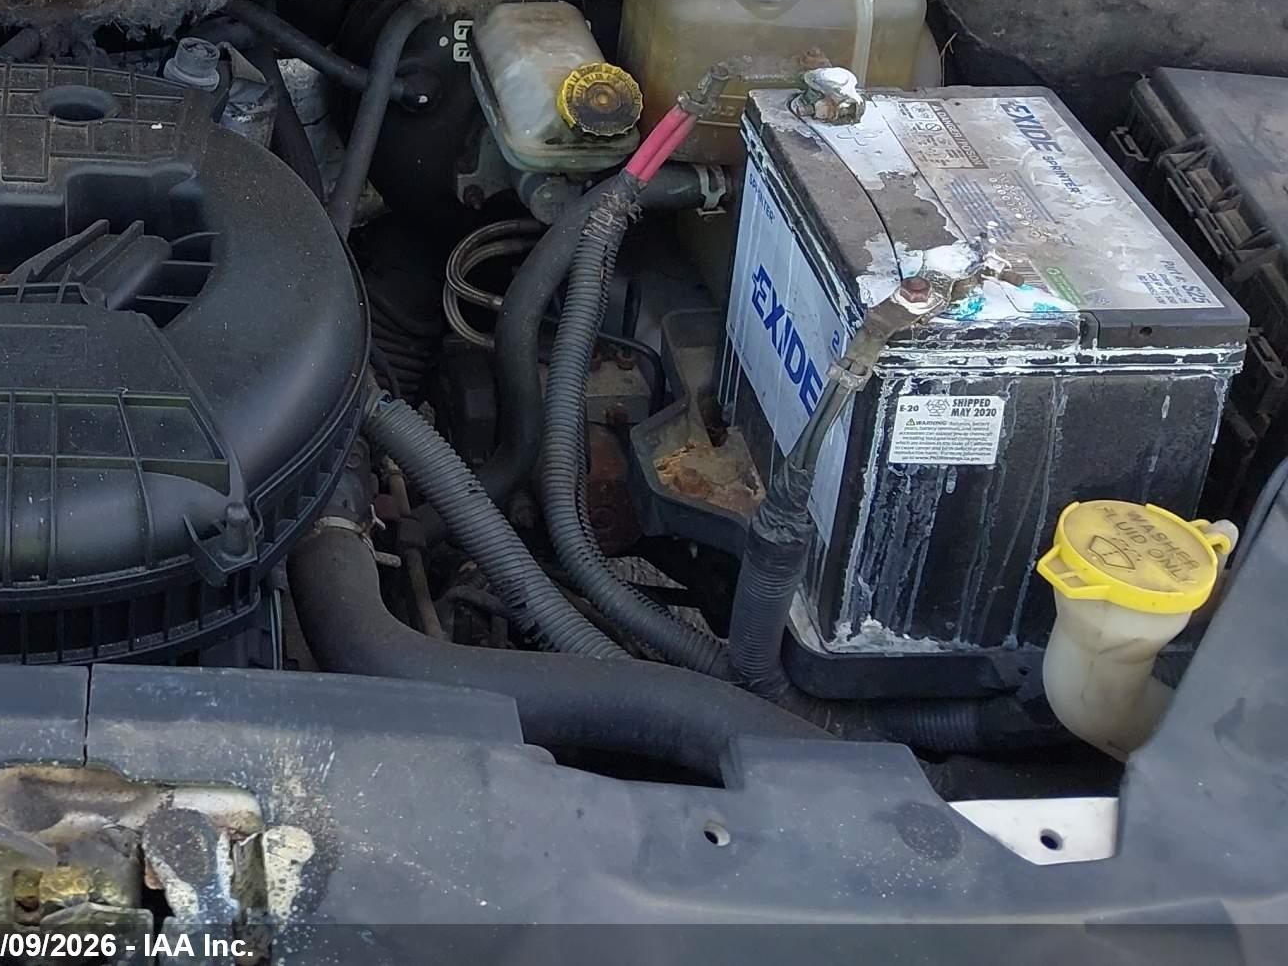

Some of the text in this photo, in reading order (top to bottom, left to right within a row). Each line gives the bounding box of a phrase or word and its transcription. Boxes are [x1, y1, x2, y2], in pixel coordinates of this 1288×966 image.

[1000, 101, 1065, 154] EXIDE
[1042, 155, 1082, 194] SPRINTER
[1182, 284, 1212, 304] S25
[752, 263, 824, 419] EXIDE
[951, 408, 997, 417] MAY 2020
[952, 398, 991, 407] SHIPPED
[1096, 506, 1198, 584] FLUID ONLY
[1127, 510, 1201, 571] WASHER
